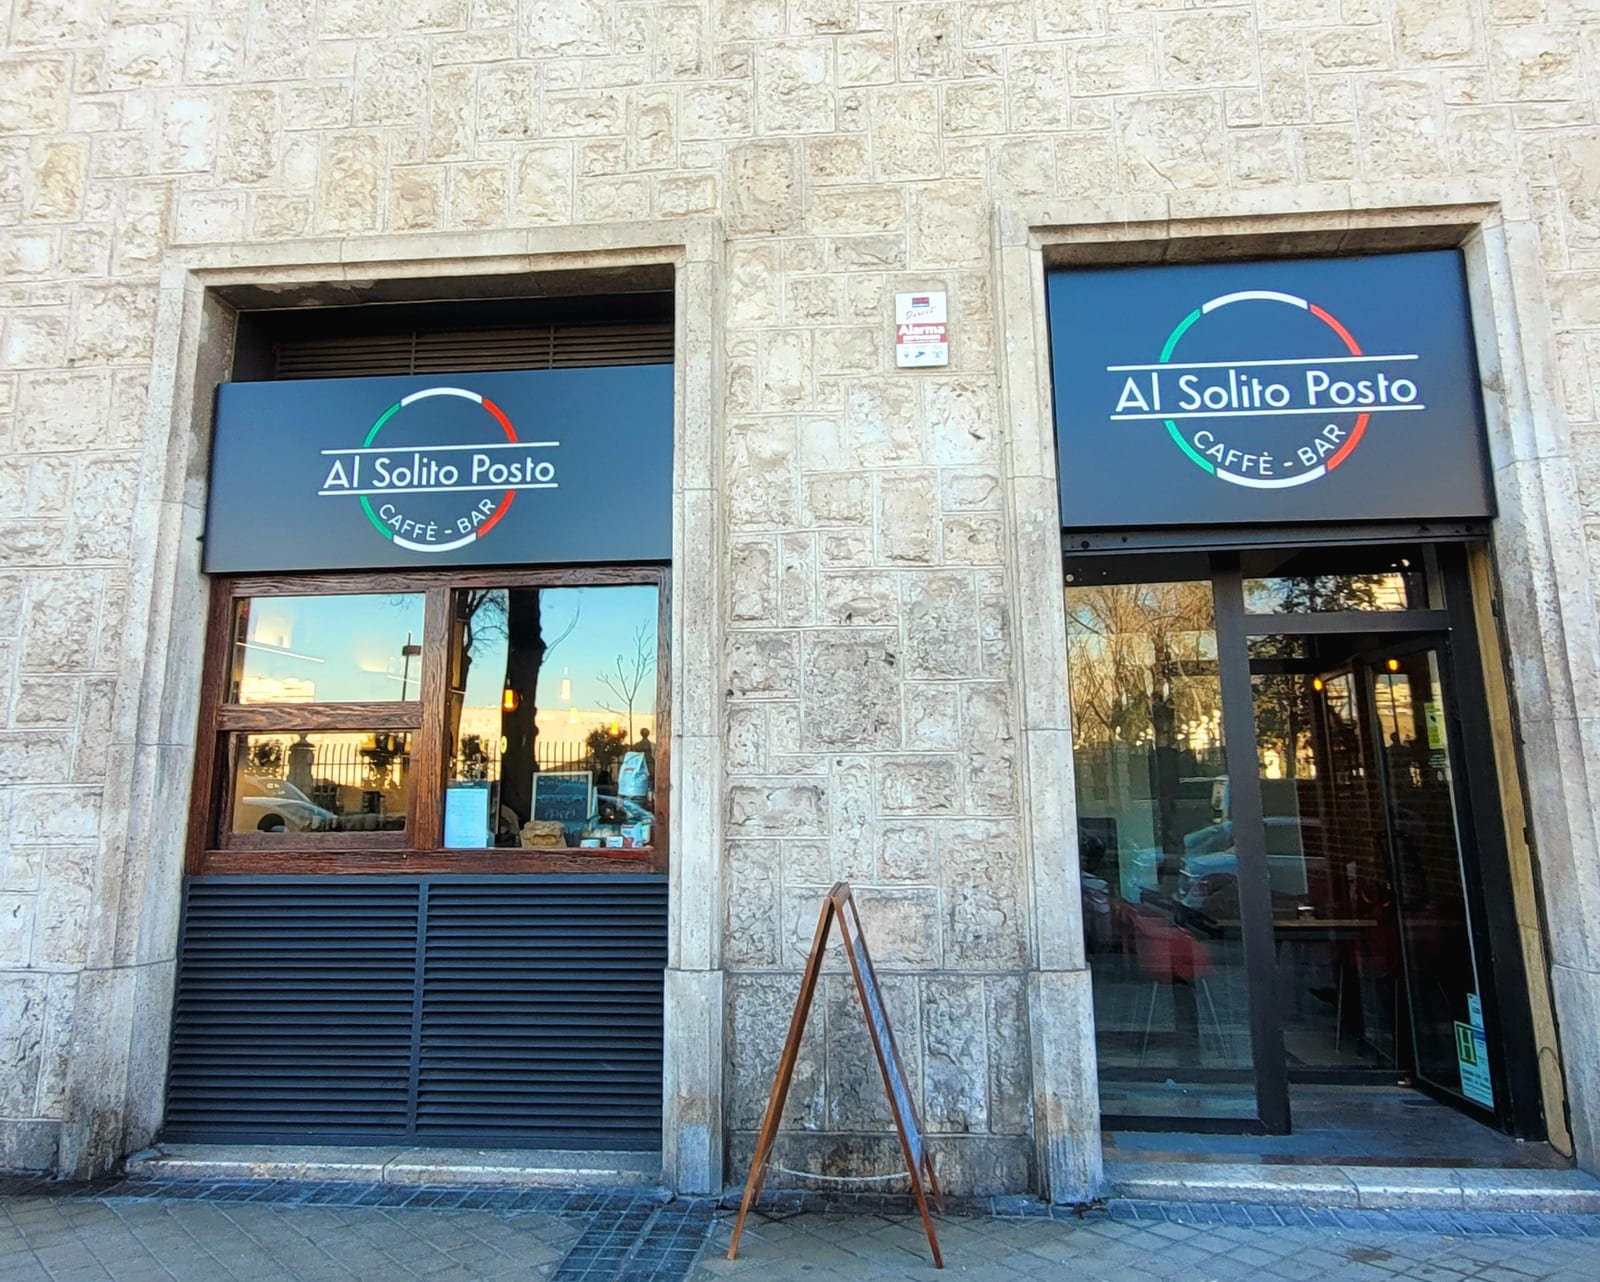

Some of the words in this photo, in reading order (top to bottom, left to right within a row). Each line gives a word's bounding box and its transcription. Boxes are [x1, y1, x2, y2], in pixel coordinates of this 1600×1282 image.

[898, 324, 945, 336] Alarma
[1115, 372, 1161, 412] Al
[1178, 369, 1290, 410] Solito
[1306, 370, 1417, 405] Posto
[323, 455, 360, 489] Al
[372, 452, 458, 488] Solito
[472, 454, 555, 484] Posto
[1193, 430, 1274, 475] CAFFÈ
[1297, 423, 1346, 467] BAR
[379, 504, 438, 541] CAFFÈ
[456, 498, 496, 534] BAR
